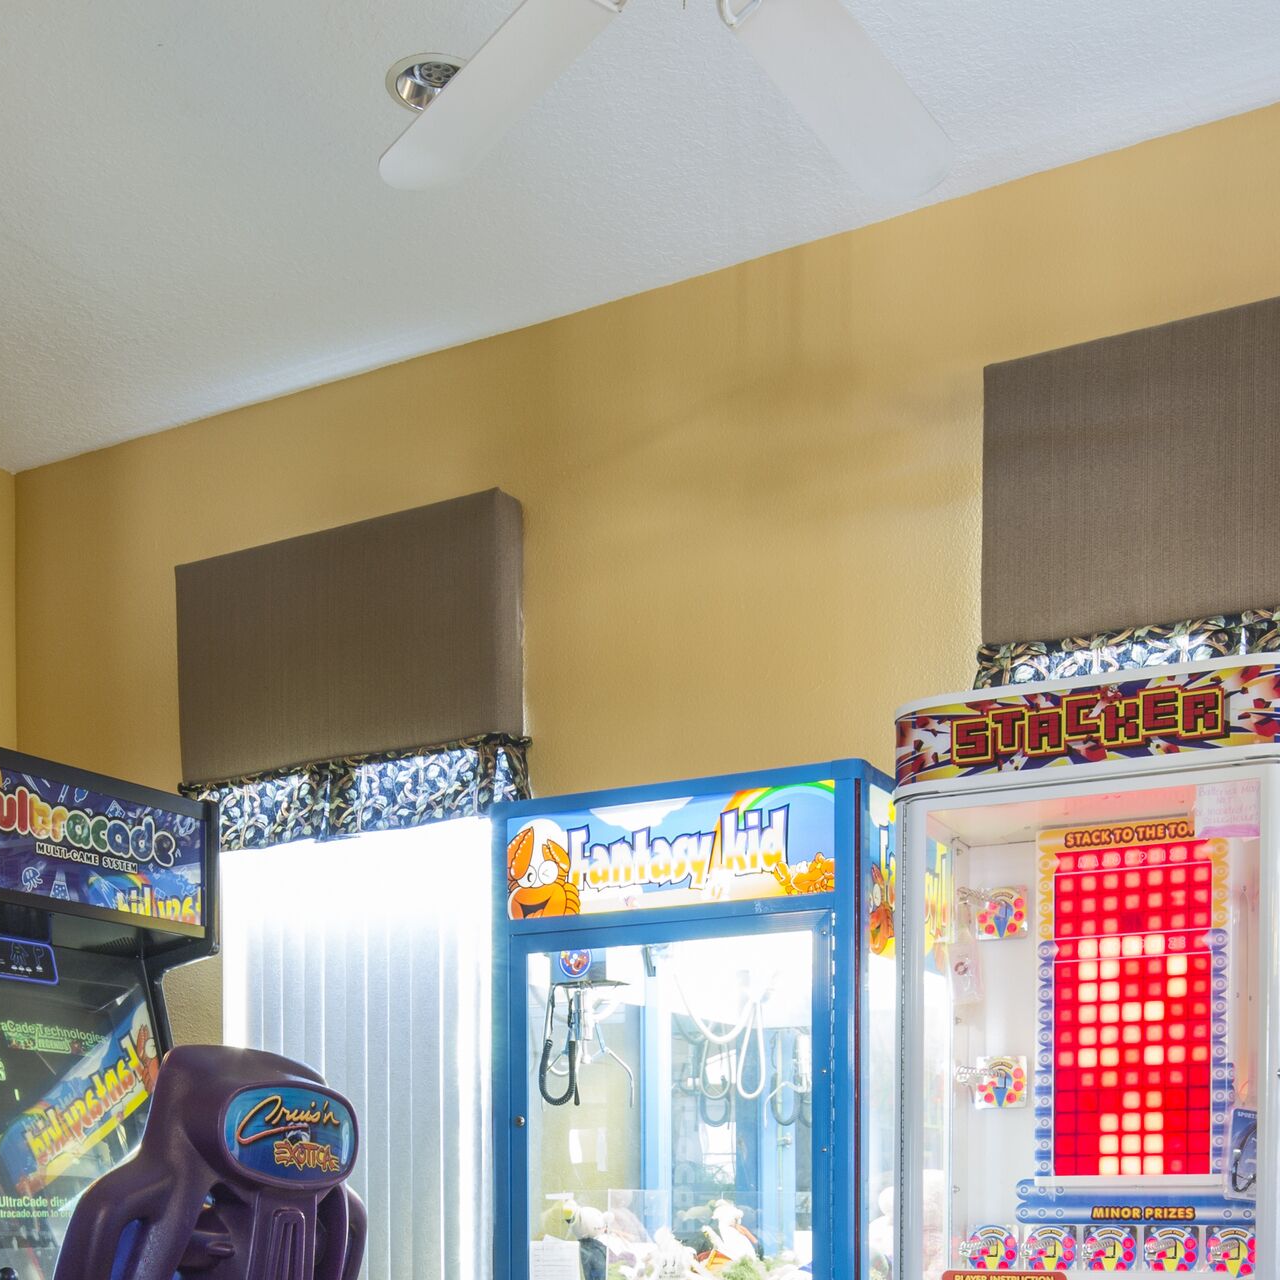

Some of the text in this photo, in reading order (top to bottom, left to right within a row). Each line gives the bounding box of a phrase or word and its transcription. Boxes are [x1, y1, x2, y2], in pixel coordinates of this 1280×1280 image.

[951, 686, 1228, 768] STACKER
[567, 803, 791, 891] Fantasy kid
[1065, 821, 1195, 848] STACK TO THE TO
[36, 841, 138, 874] MULTI-GAME SYSTEM
[236, 1094, 341, 1145] Cruis'n
[273, 1139, 341, 1173] EXOTICA
[1091, 1205, 1196, 1221] MINOR PRIZES
